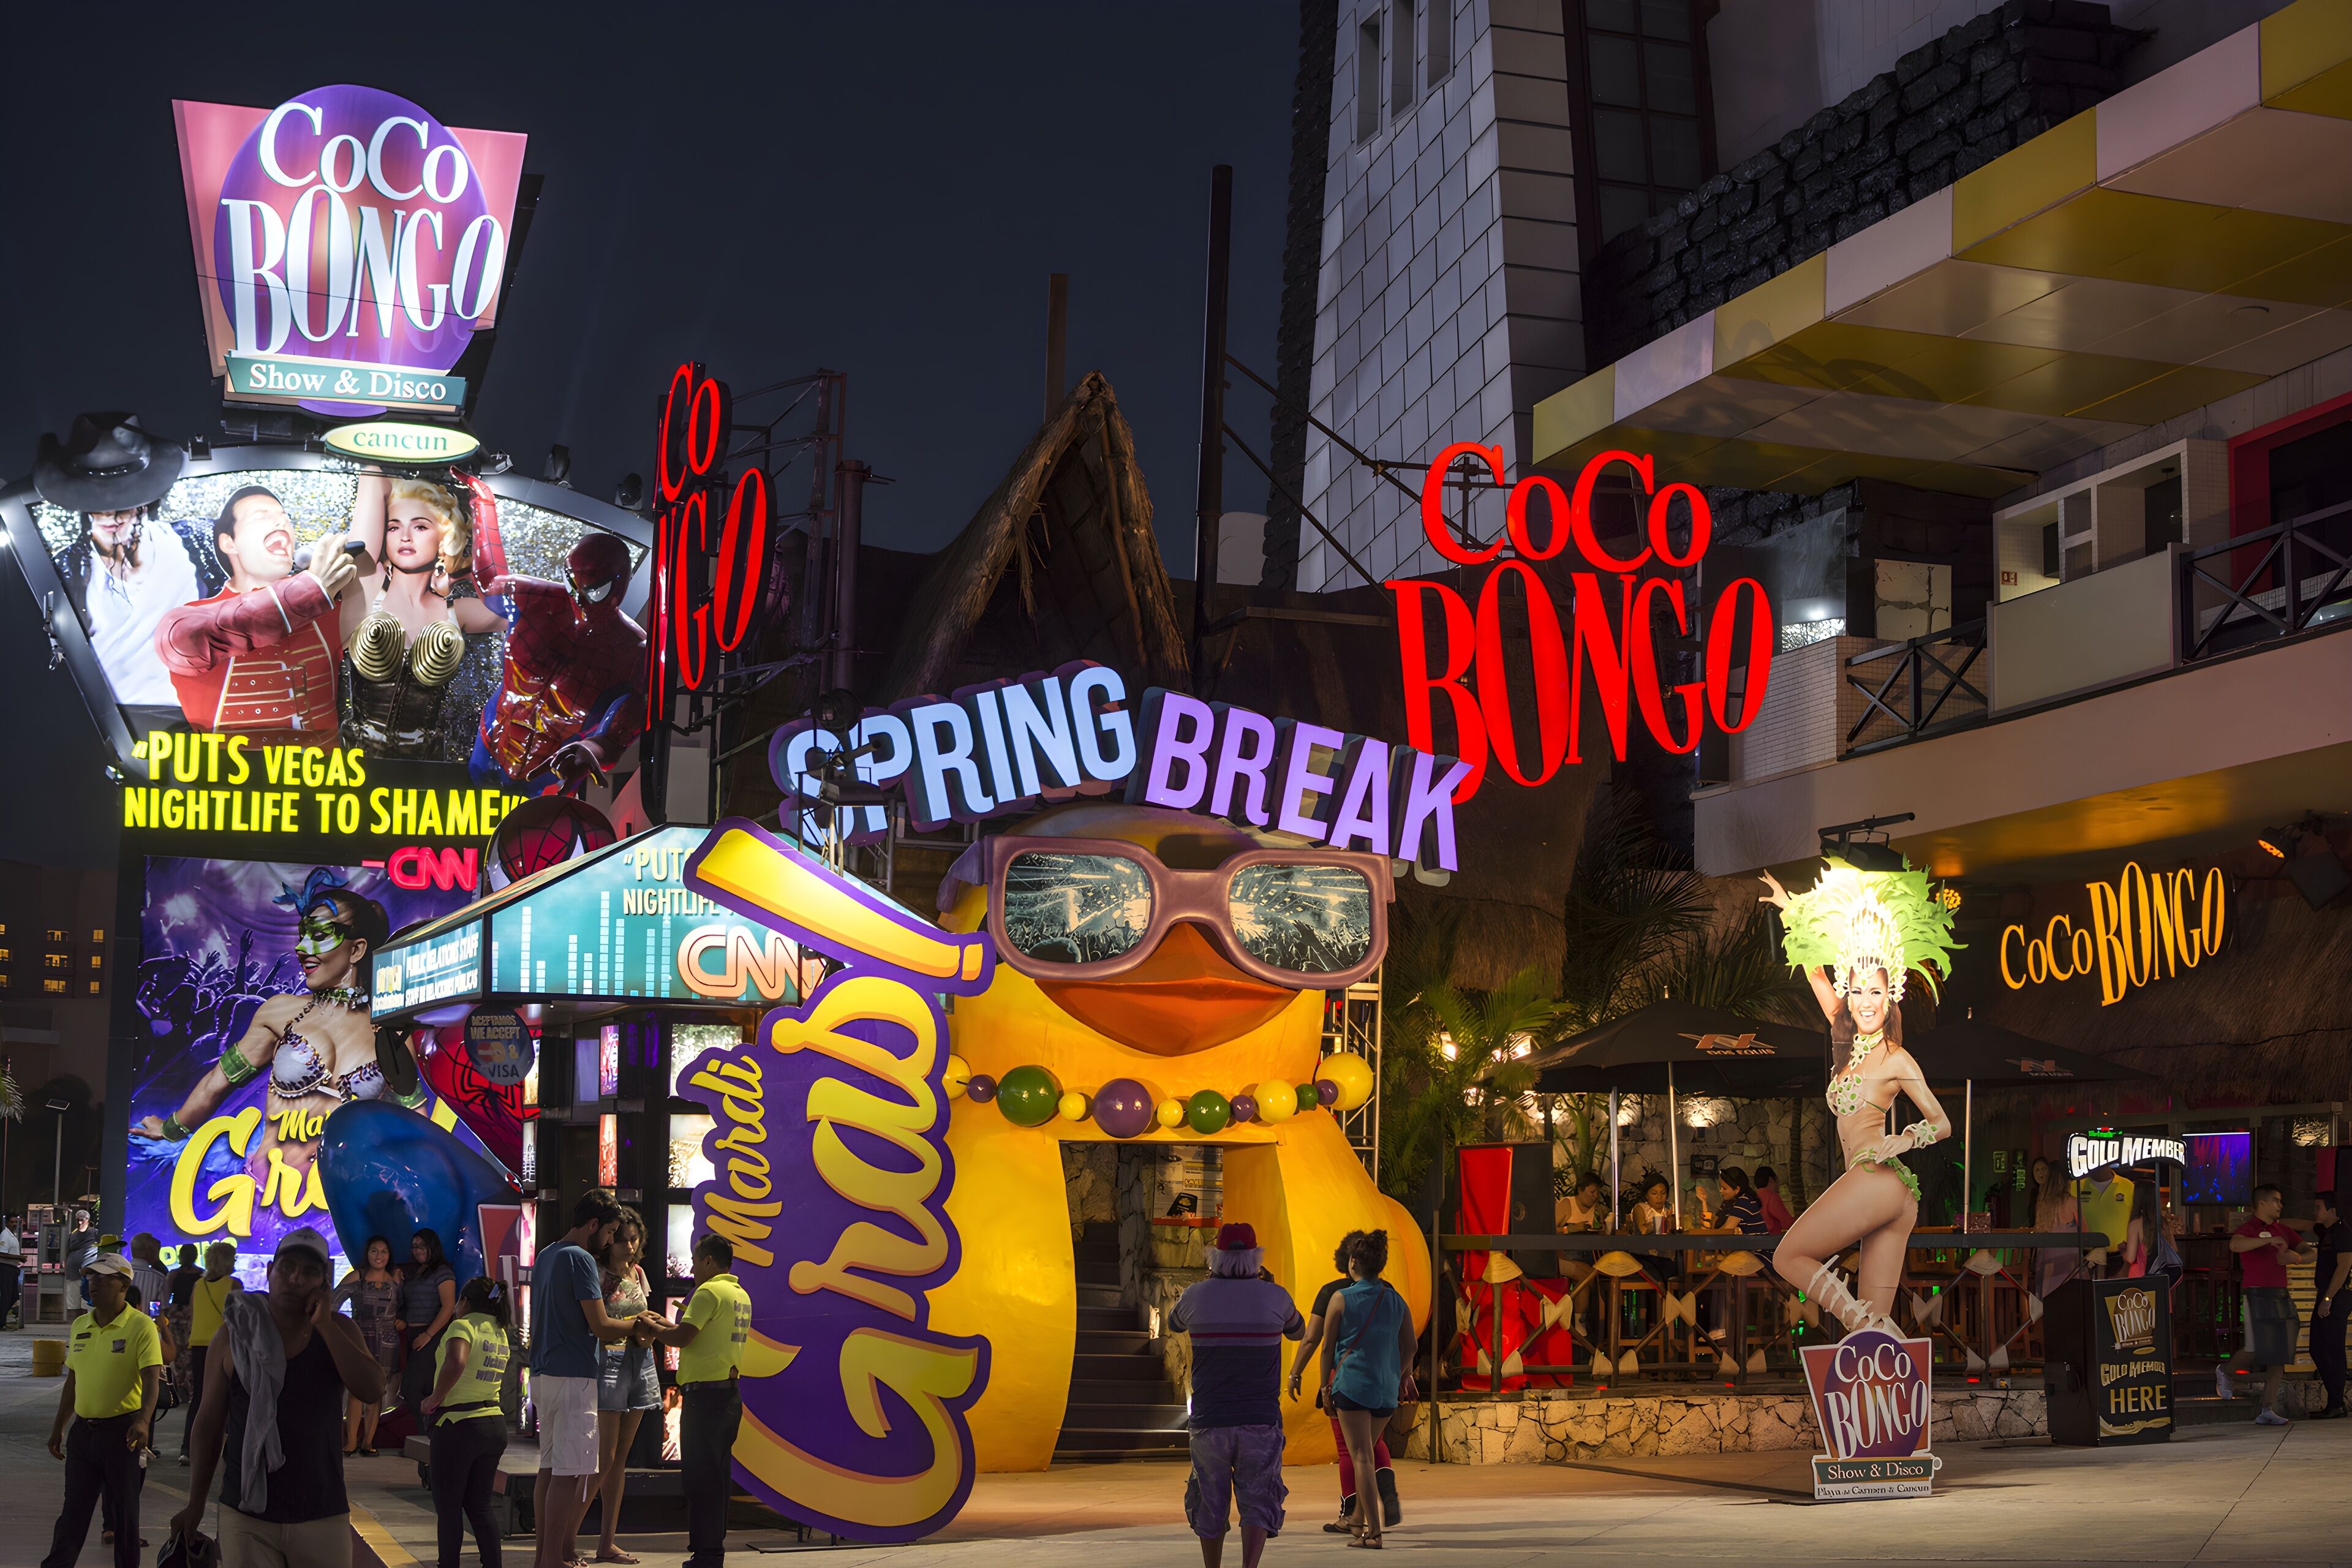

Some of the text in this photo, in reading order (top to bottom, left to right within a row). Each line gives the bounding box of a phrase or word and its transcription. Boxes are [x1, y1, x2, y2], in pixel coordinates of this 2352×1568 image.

[221, 184, 505, 356] BONGO
[249, 363, 447, 401] Show & Disco
[352, 431, 448, 451] cancun
[1384, 559, 1774, 805] BONGO
[263, 745, 366, 787] VEGAS
[786, 666, 1474, 872] SPRING BREAK
[124, 786, 300, 833] NIGHTLIFE
[315, 793, 360, 834] TO
[2086, 861, 2225, 1007] BONGO
[677, 924, 827, 1001] CNN
[488, 1064, 520, 1078] VISA
[690, 1054, 783, 1268] Mardi
[2070, 1136, 2120, 1178] GOLD
[2100, 1363, 2128, 1387] GOLD
[1824, 1379, 1928, 1461] BONGO
[2109, 1384, 2168, 1414] HERE
[1828, 1461, 1924, 1480] Show & Disco
